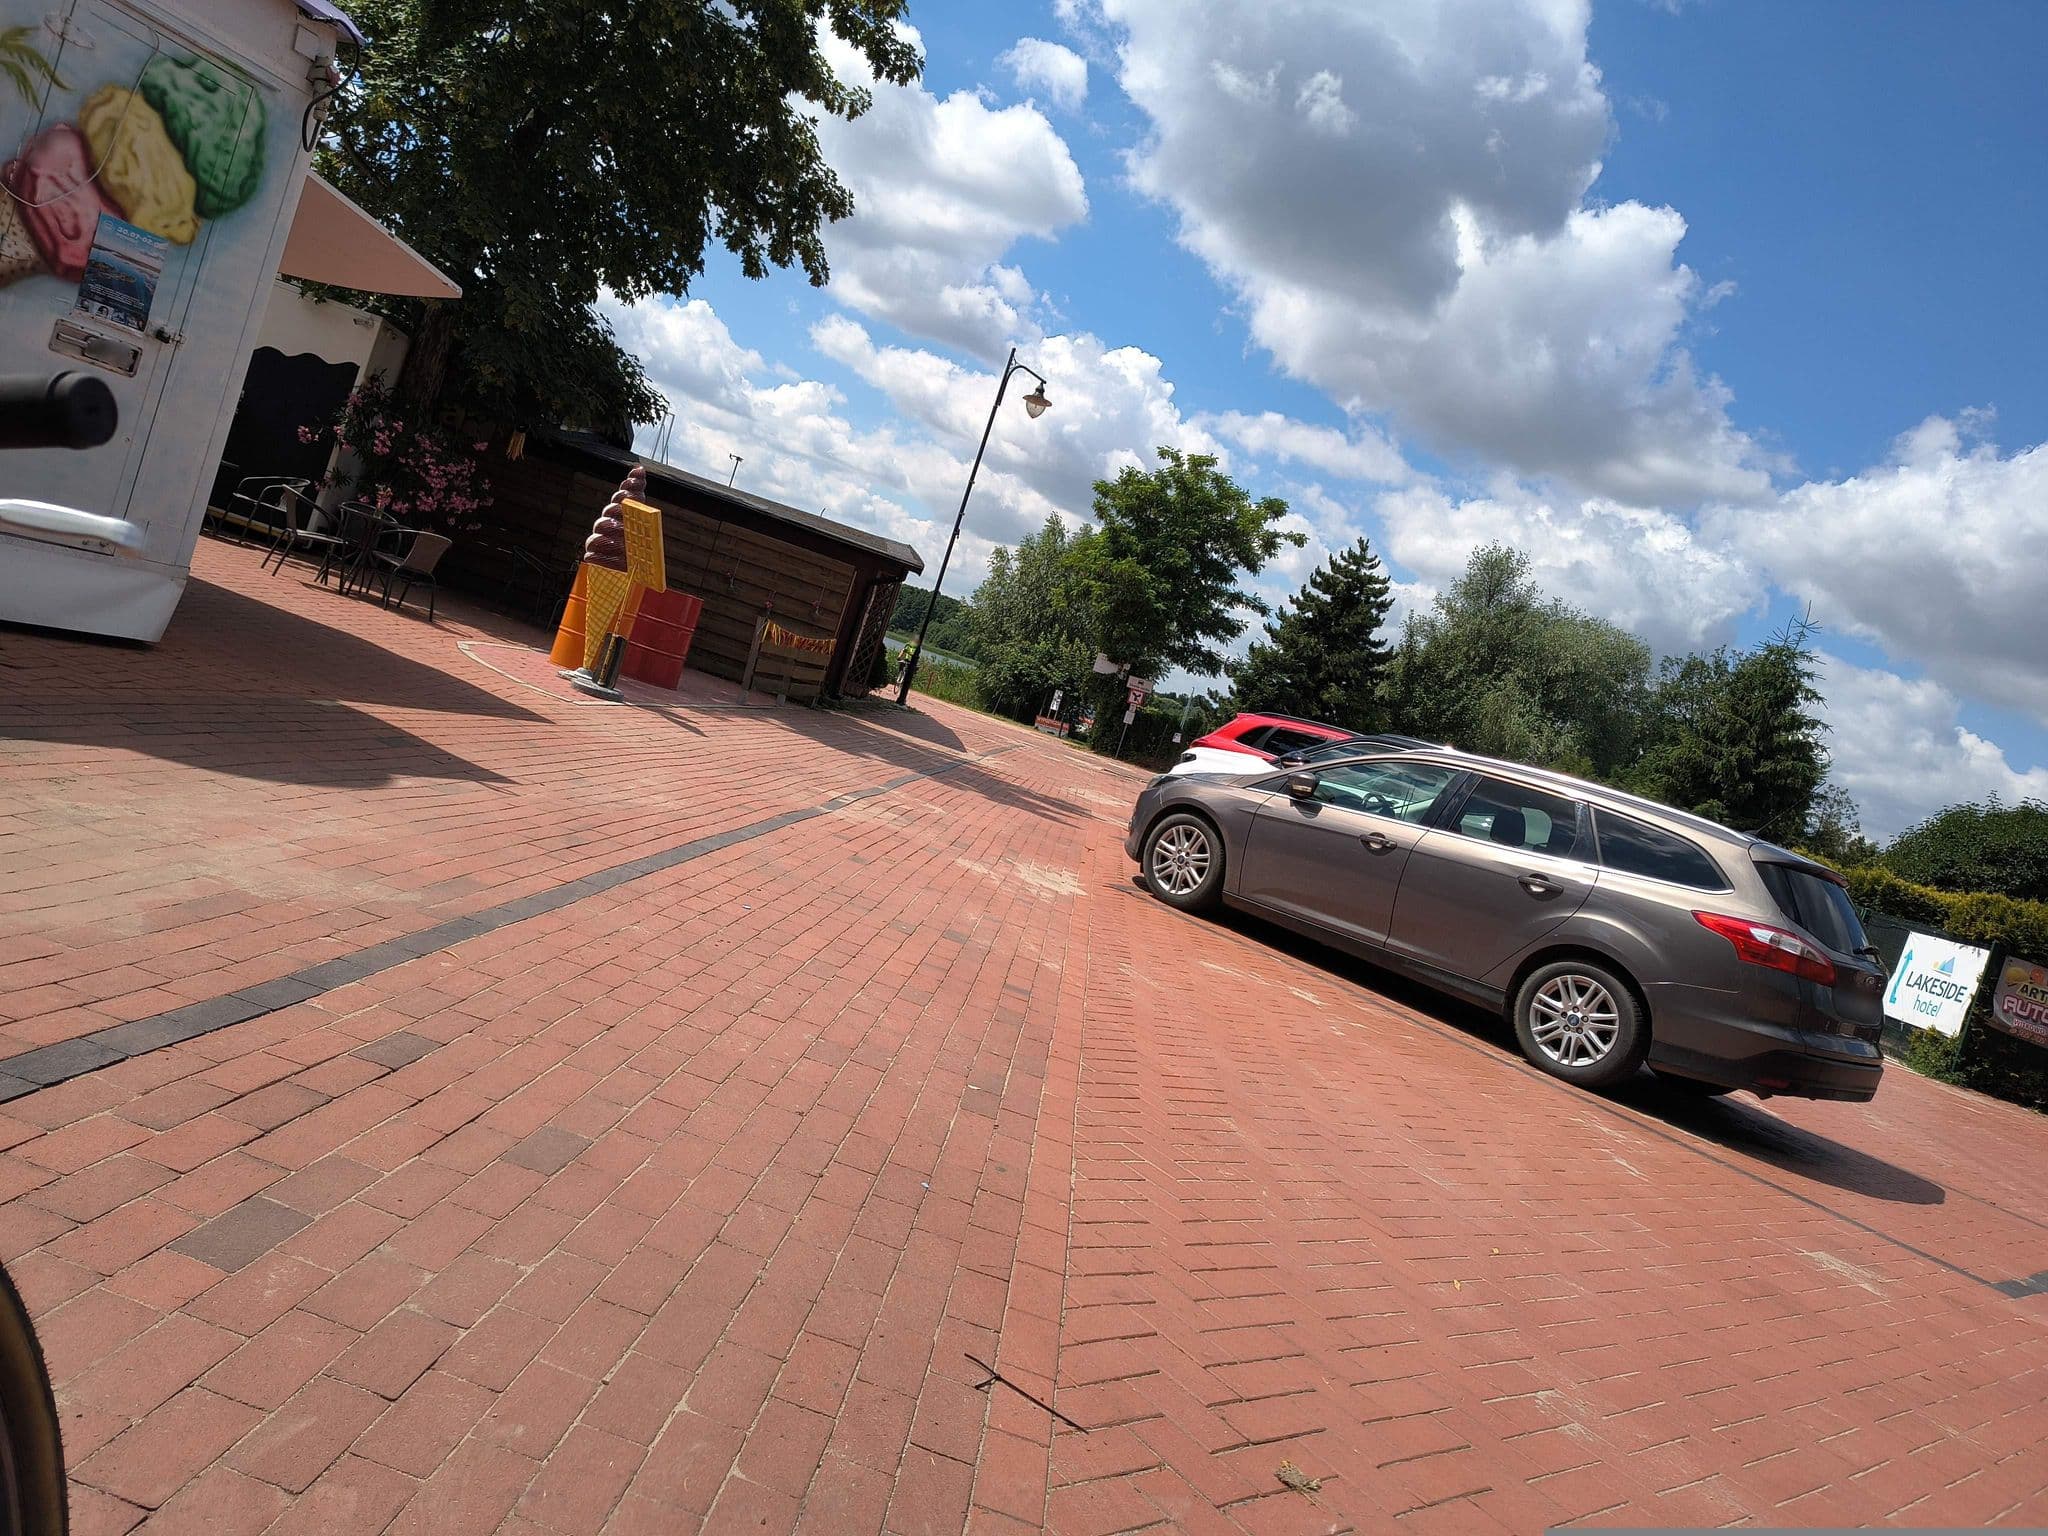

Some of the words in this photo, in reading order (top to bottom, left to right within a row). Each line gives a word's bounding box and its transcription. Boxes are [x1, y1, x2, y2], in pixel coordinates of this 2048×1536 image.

[1905, 971, 1967, 1003] LAKESIDE
[2020, 984, 2048, 1003] ART
[1913, 994, 1943, 1017] hotel
